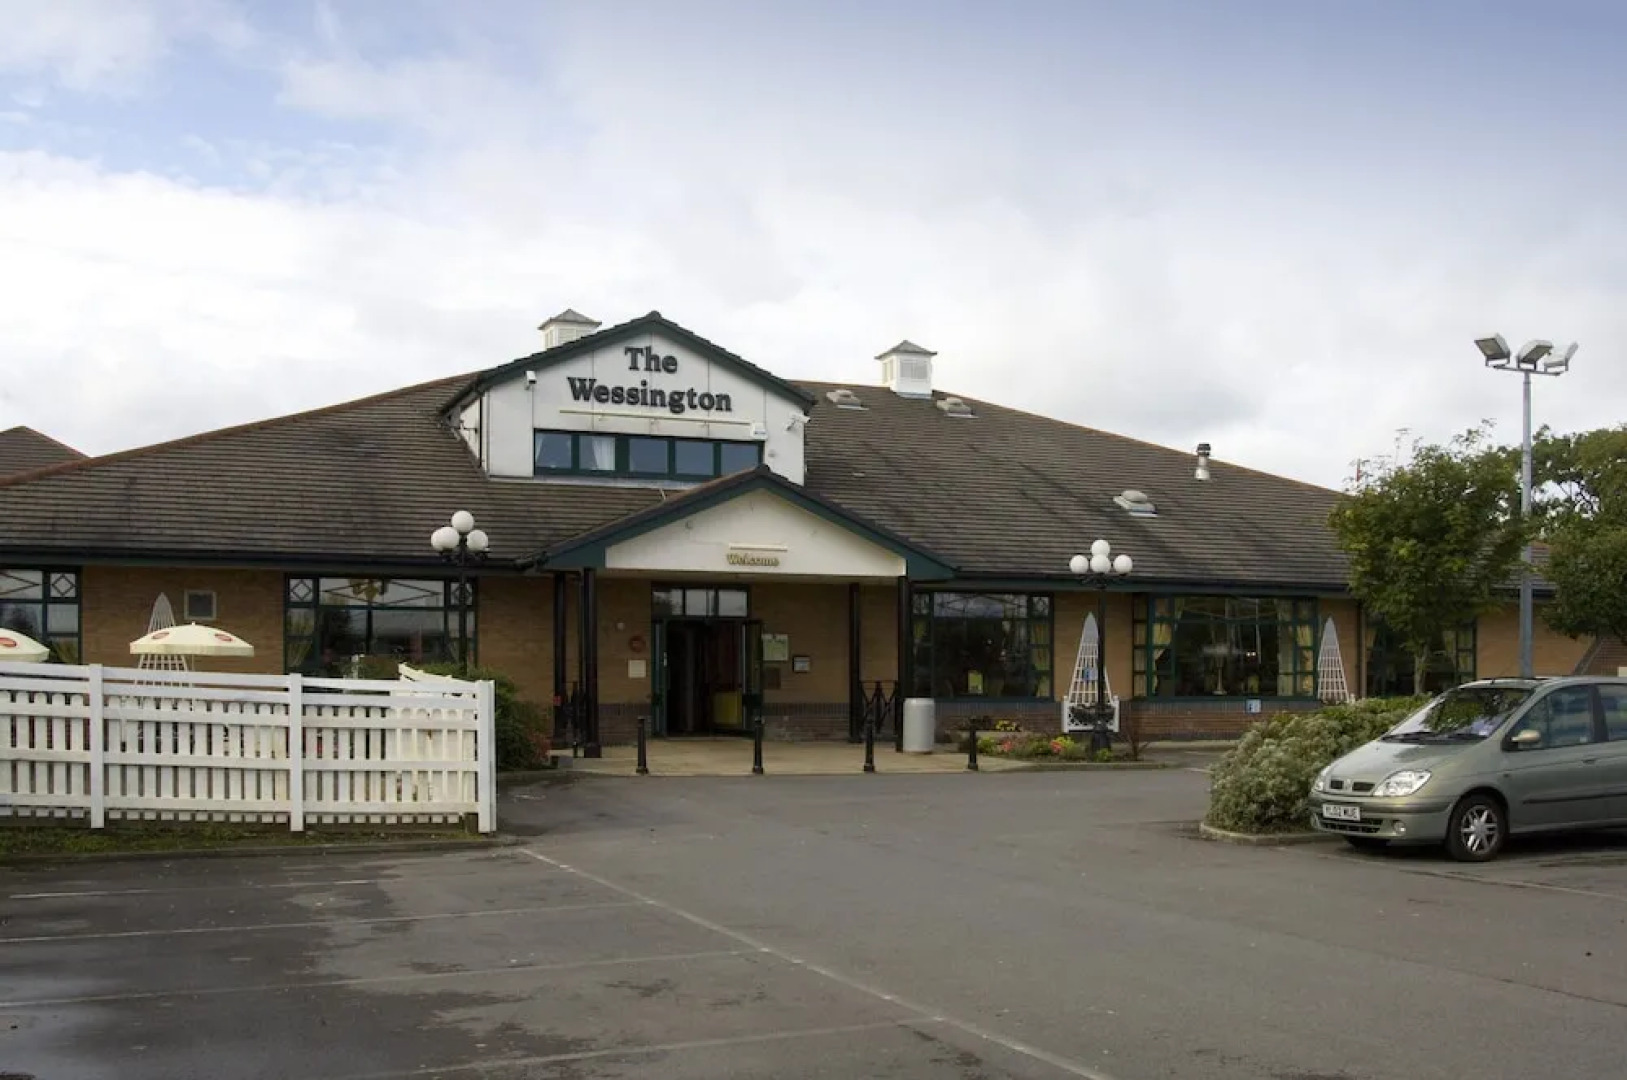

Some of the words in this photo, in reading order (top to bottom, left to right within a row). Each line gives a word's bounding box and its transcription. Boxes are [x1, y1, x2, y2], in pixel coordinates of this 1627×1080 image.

[624, 345, 678, 374] The
[567, 377, 732, 413] Wessington
[727, 553, 779, 566] Welcome
